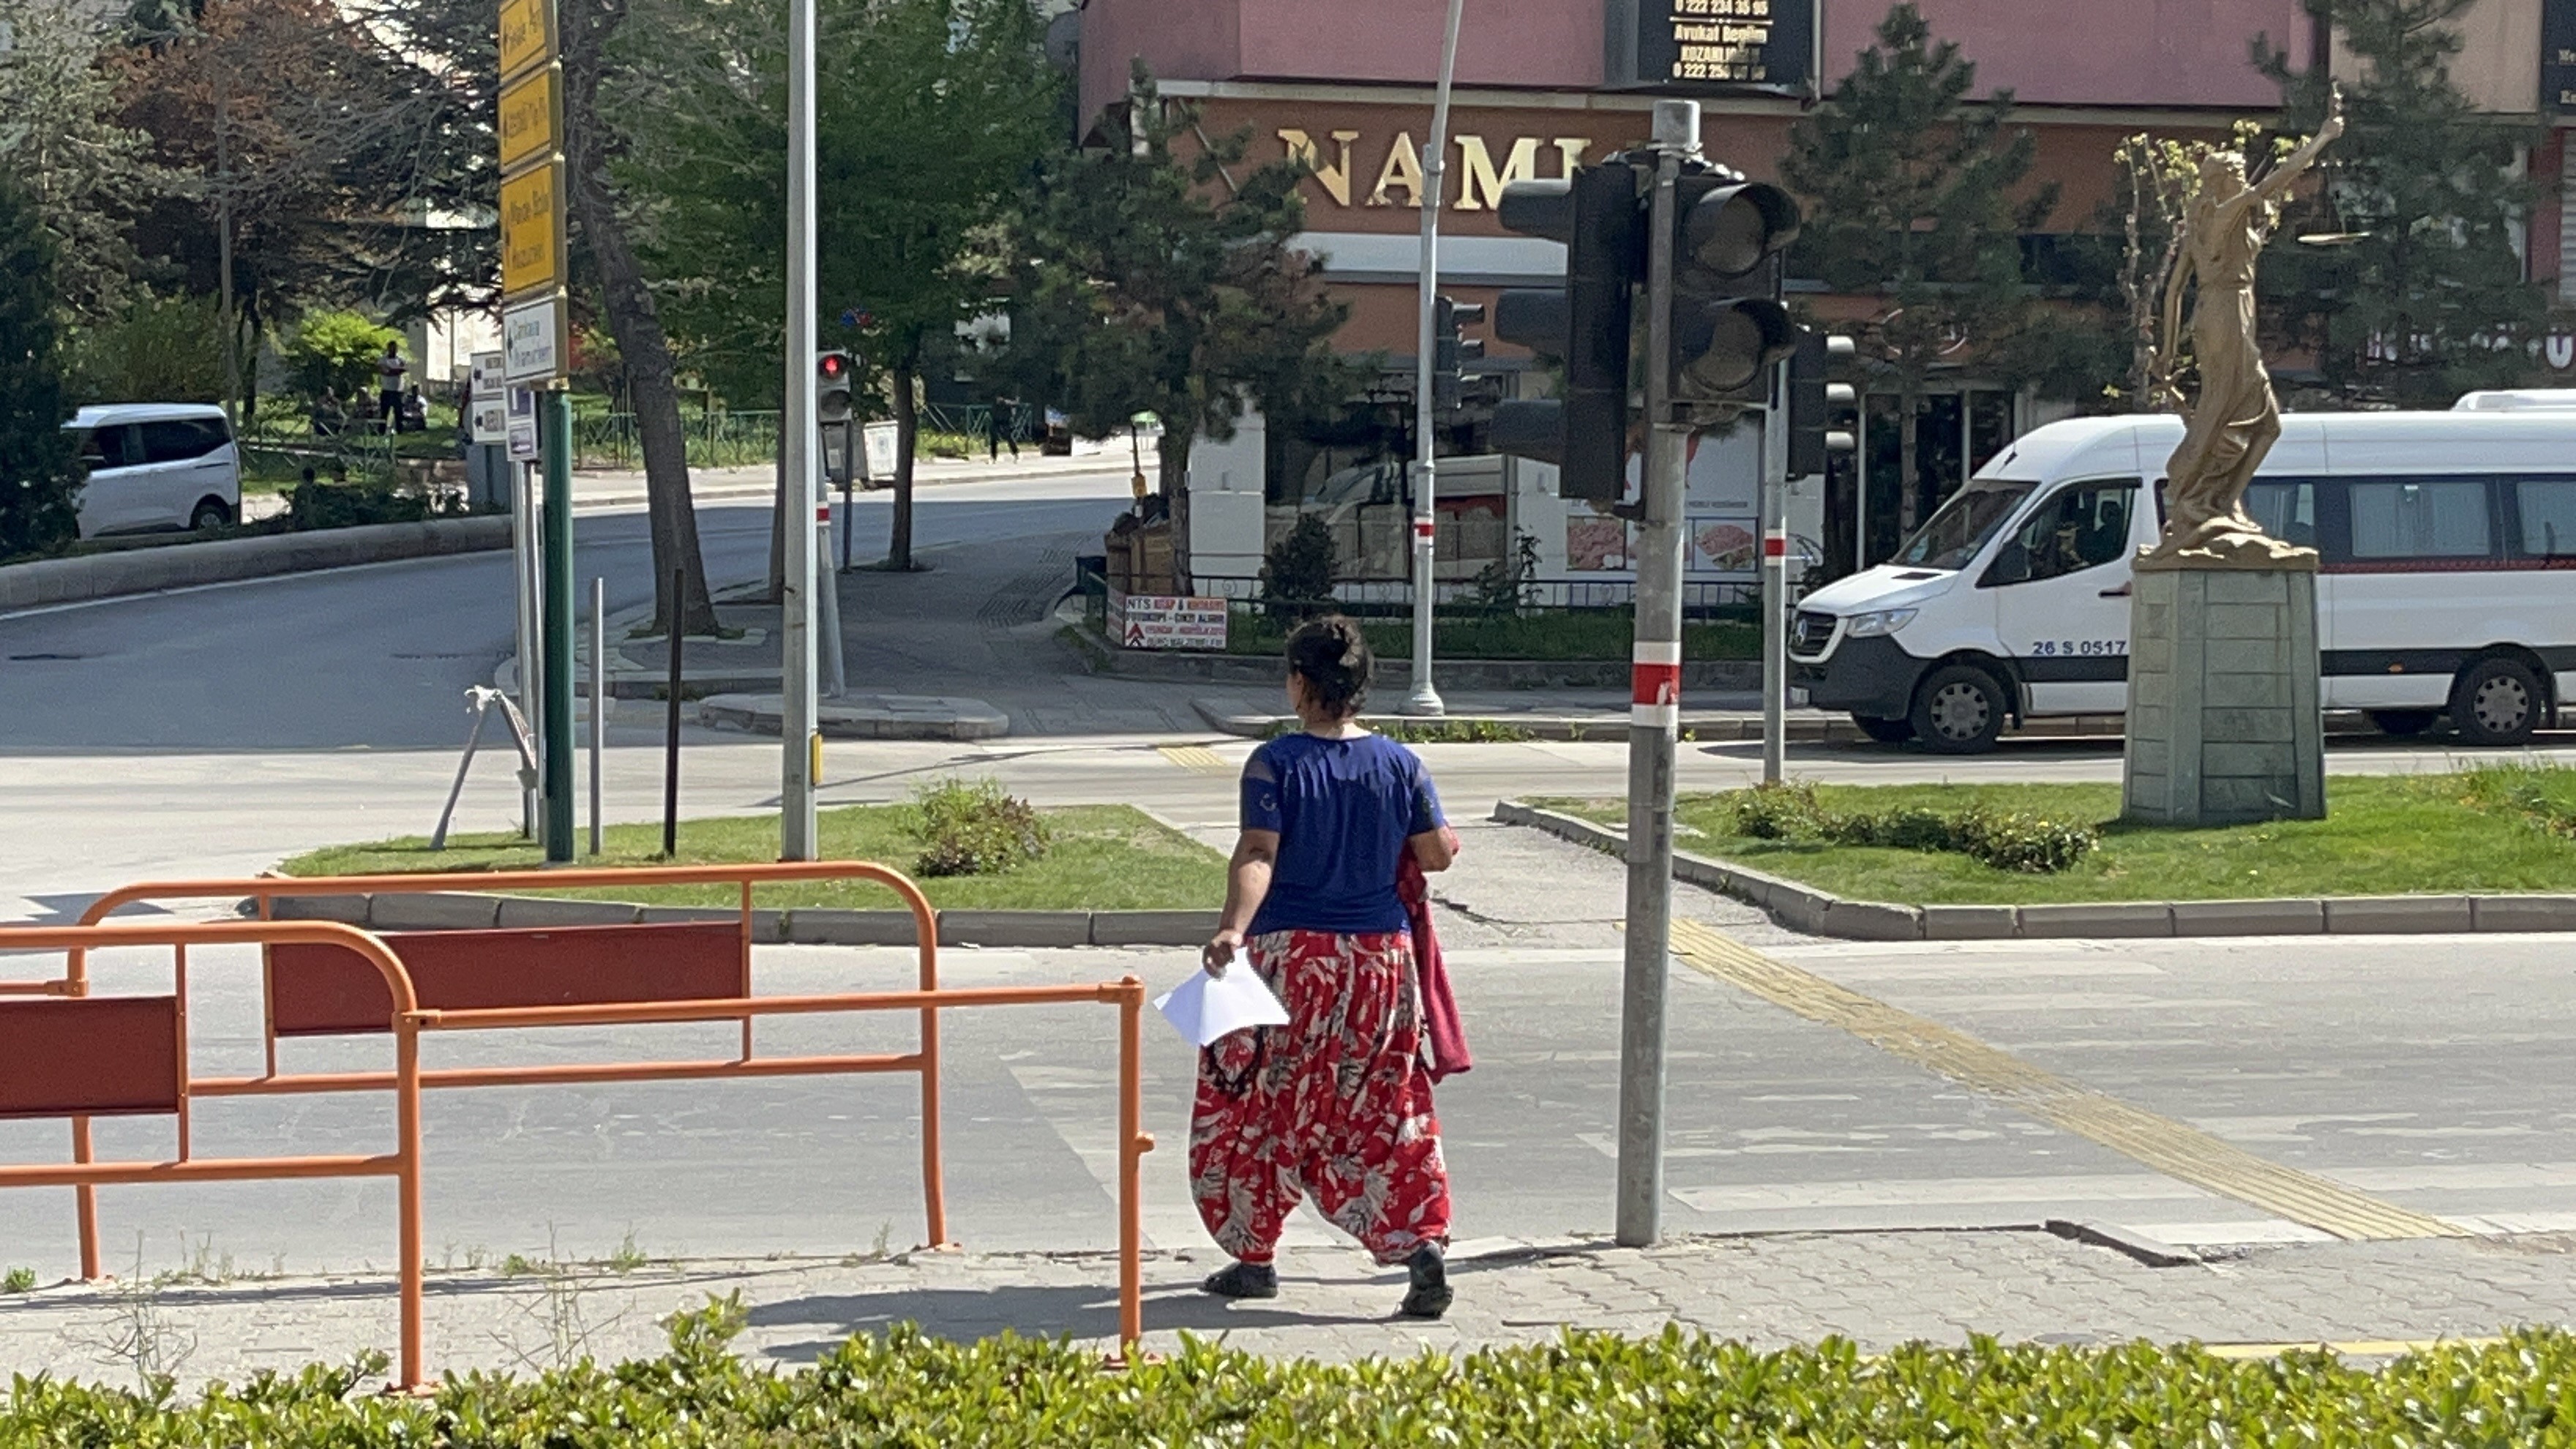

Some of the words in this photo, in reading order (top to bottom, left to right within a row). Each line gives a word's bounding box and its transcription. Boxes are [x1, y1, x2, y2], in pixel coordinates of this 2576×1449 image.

[1674, 23, 1720, 42] Avukat
[1683, 63, 1707, 78] 222
[1128, 599, 1151, 610] NTS
[2032, 641, 2056, 655] 26
[2062, 641, 2075, 655] S
[2080, 640, 2127, 655] 0517
